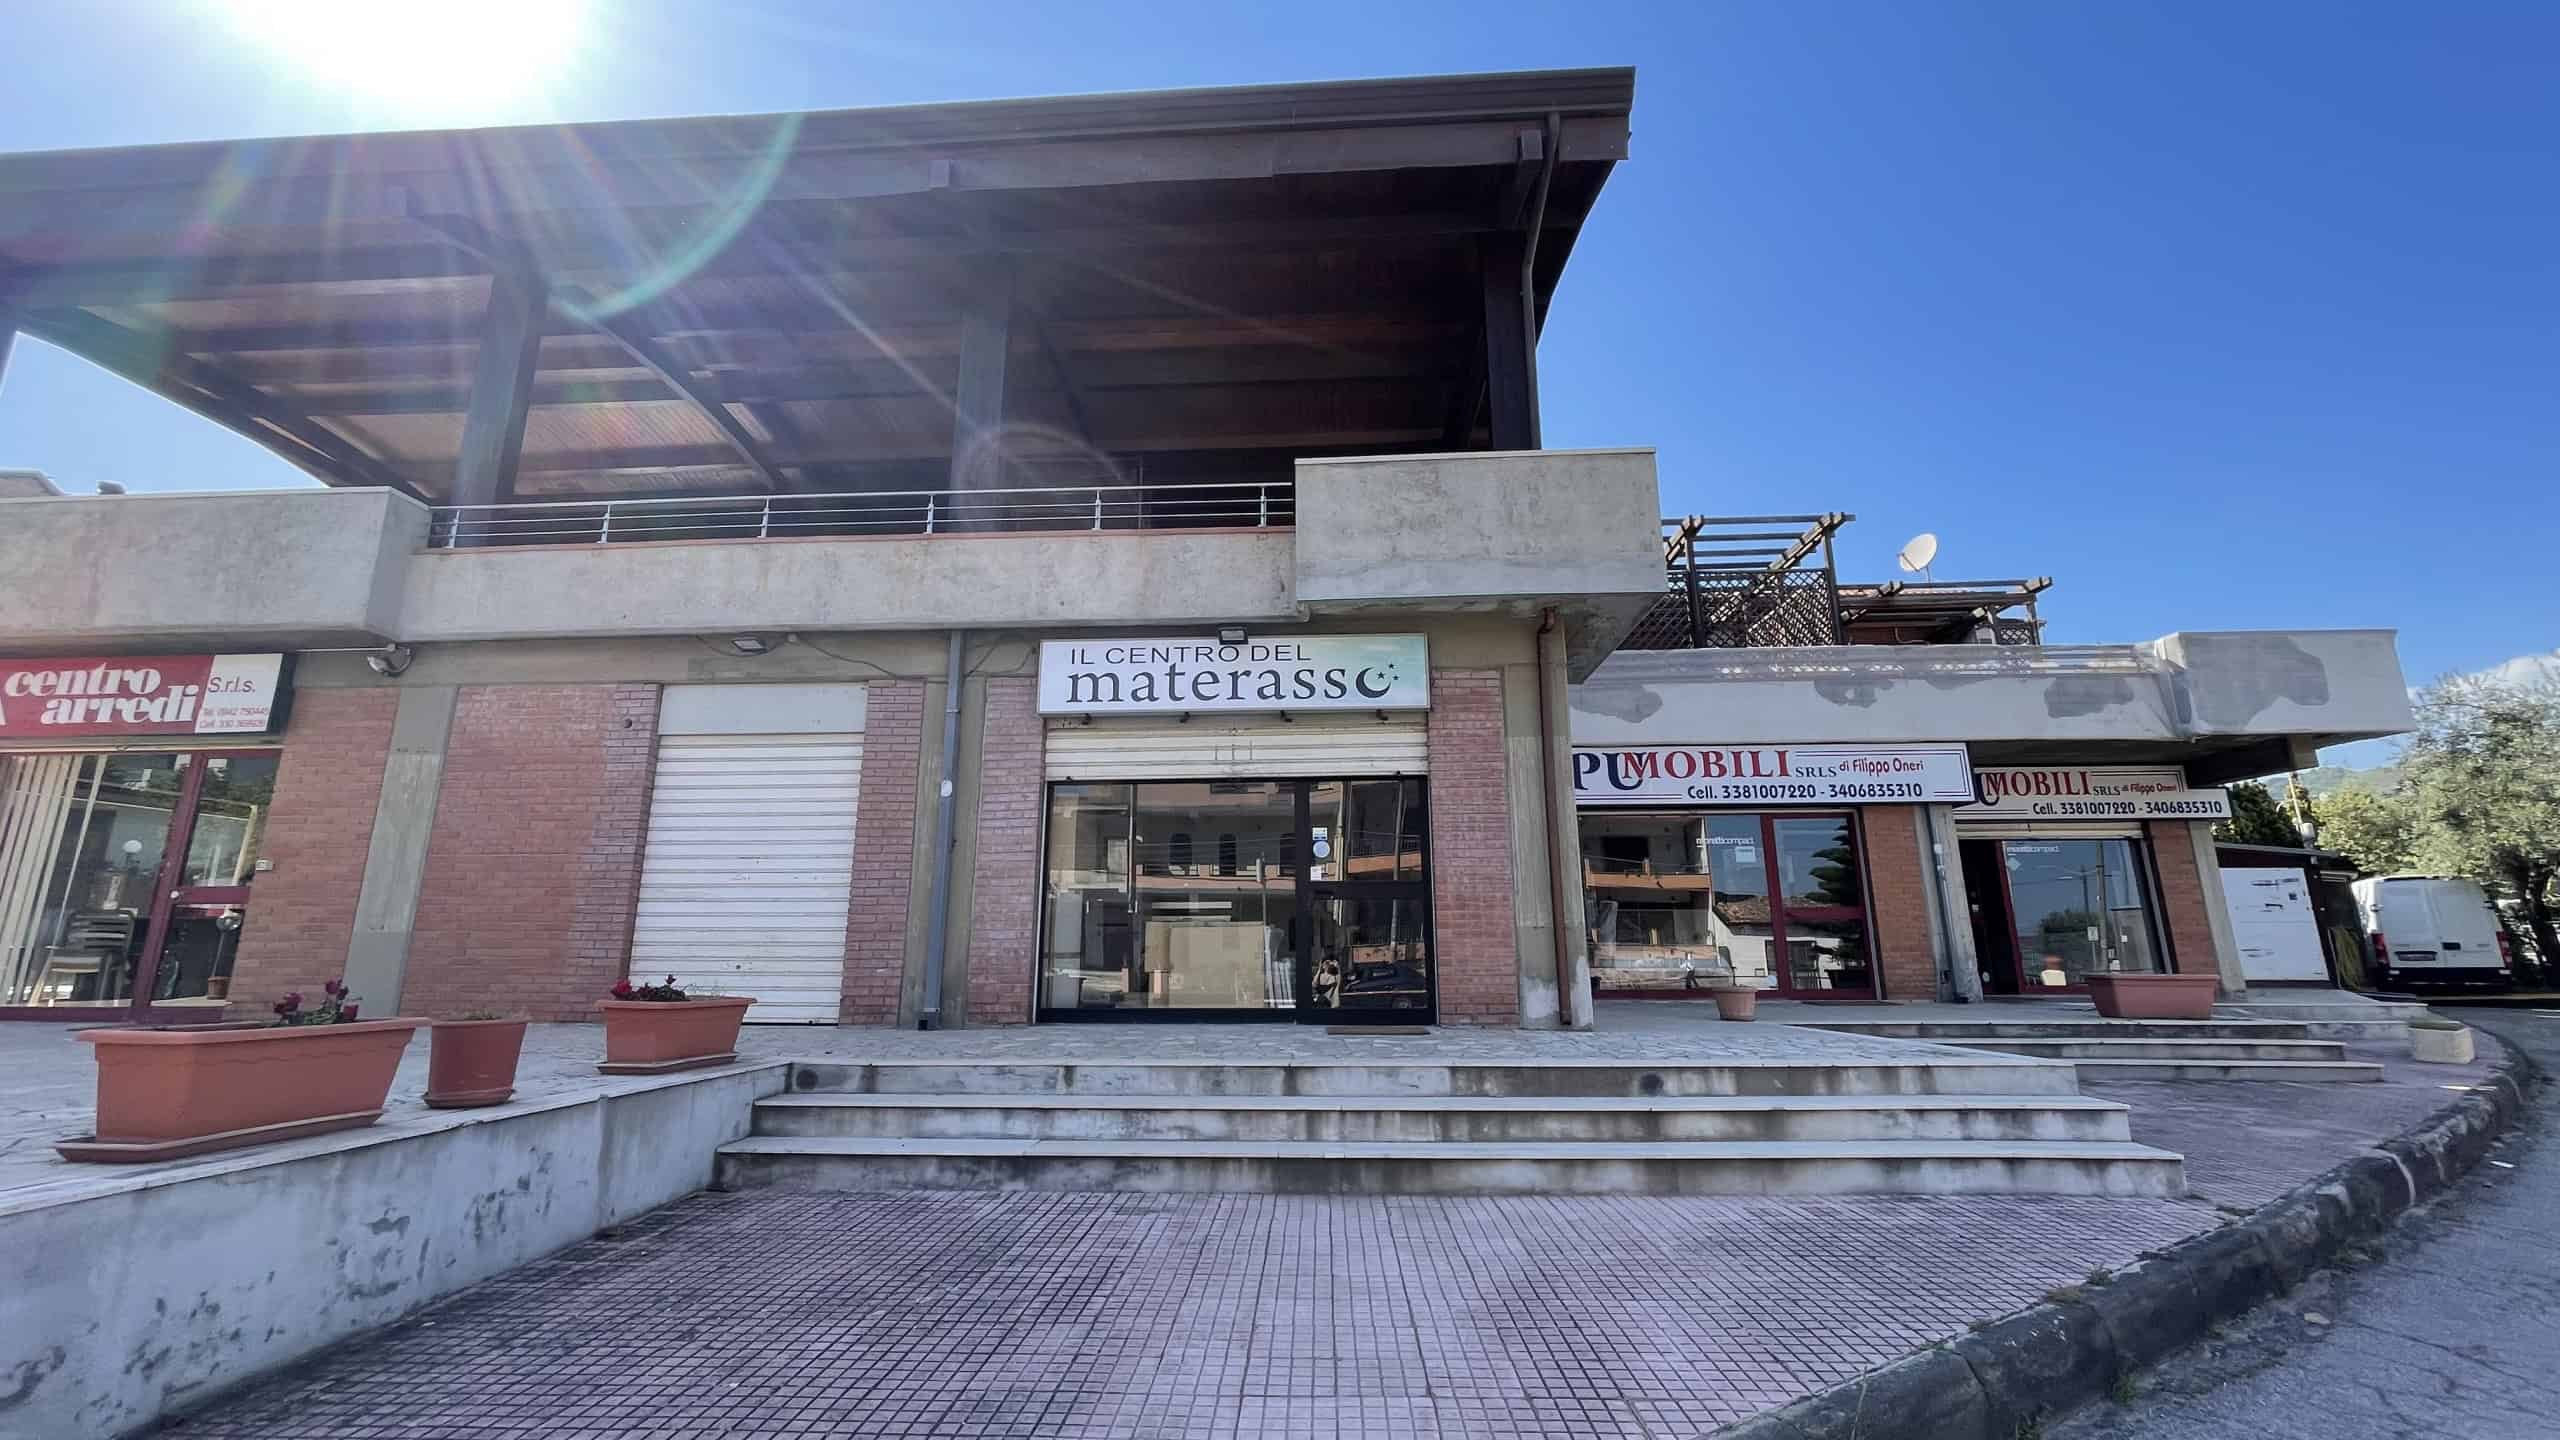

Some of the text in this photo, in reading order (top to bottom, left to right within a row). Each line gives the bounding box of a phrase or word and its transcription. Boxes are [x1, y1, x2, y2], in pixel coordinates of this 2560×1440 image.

[1070, 644, 1312, 664] IL CENTRO DEL
[4, 661, 161, 697] centro
[207, 676, 256, 693] S.r.l.s.
[40, 684, 199, 725] arredi
[1795, 766, 1837, 778] SRLS
[1839, 760, 1850, 772] di
[1853, 757, 1890, 776] Filippo
[1893, 757, 1924, 772] Oneri
[1687, 785, 1718, 799] Cell.
[1722, 784, 1816, 799] 3381007220
[1829, 783, 1922, 798] 3406835310
[2093, 785, 2121, 796] SRLS
[2032, 802, 2057, 815] Cell.
[2061, 802, 2136, 815] 3381007220
[2145, 801, 2223, 814] 3406835310
